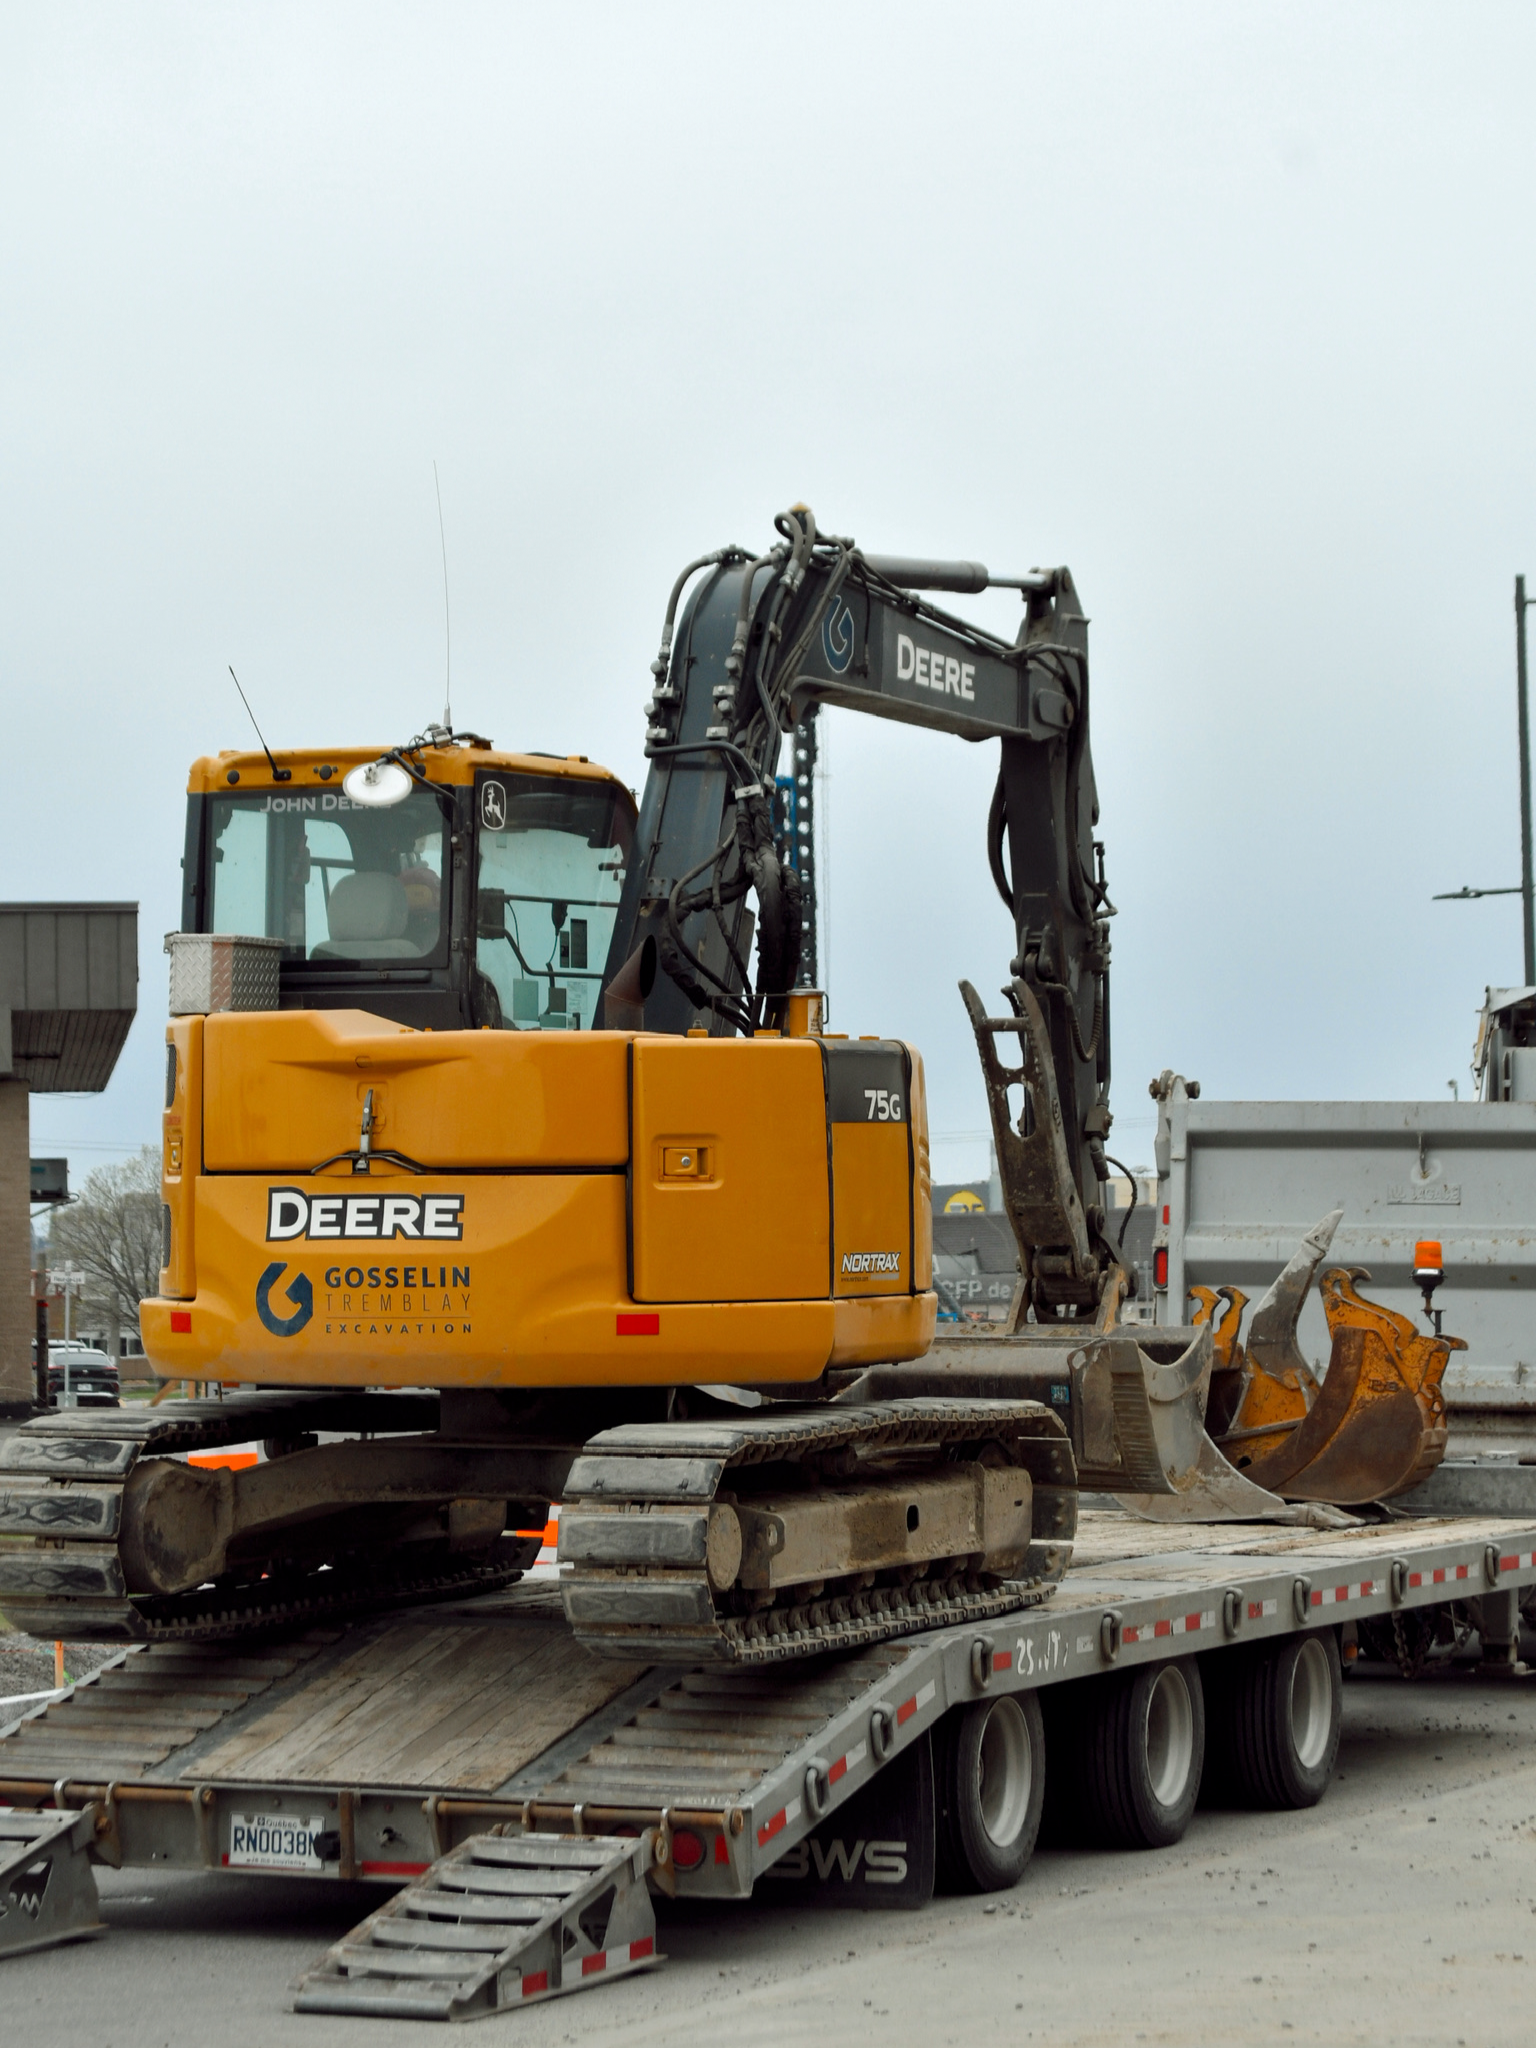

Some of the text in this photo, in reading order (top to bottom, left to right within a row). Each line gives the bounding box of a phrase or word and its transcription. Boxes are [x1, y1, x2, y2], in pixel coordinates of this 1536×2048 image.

[897, 633, 975, 701] DEERE
[260, 794, 391, 812] JOHN DEE
[864, 1089, 901, 1121] 75G
[267, 1188, 463, 1240] DEERE
[841, 1252, 900, 1273] NORTRAX
[325, 1266, 470, 1288] GOSSELIN
[988, 1281, 1011, 1298] de
[325, 1293, 471, 1311] TREMBLAY
[326, 1323, 471, 1334] EXCAVATION
[266, 1819, 297, 1829] Québec
